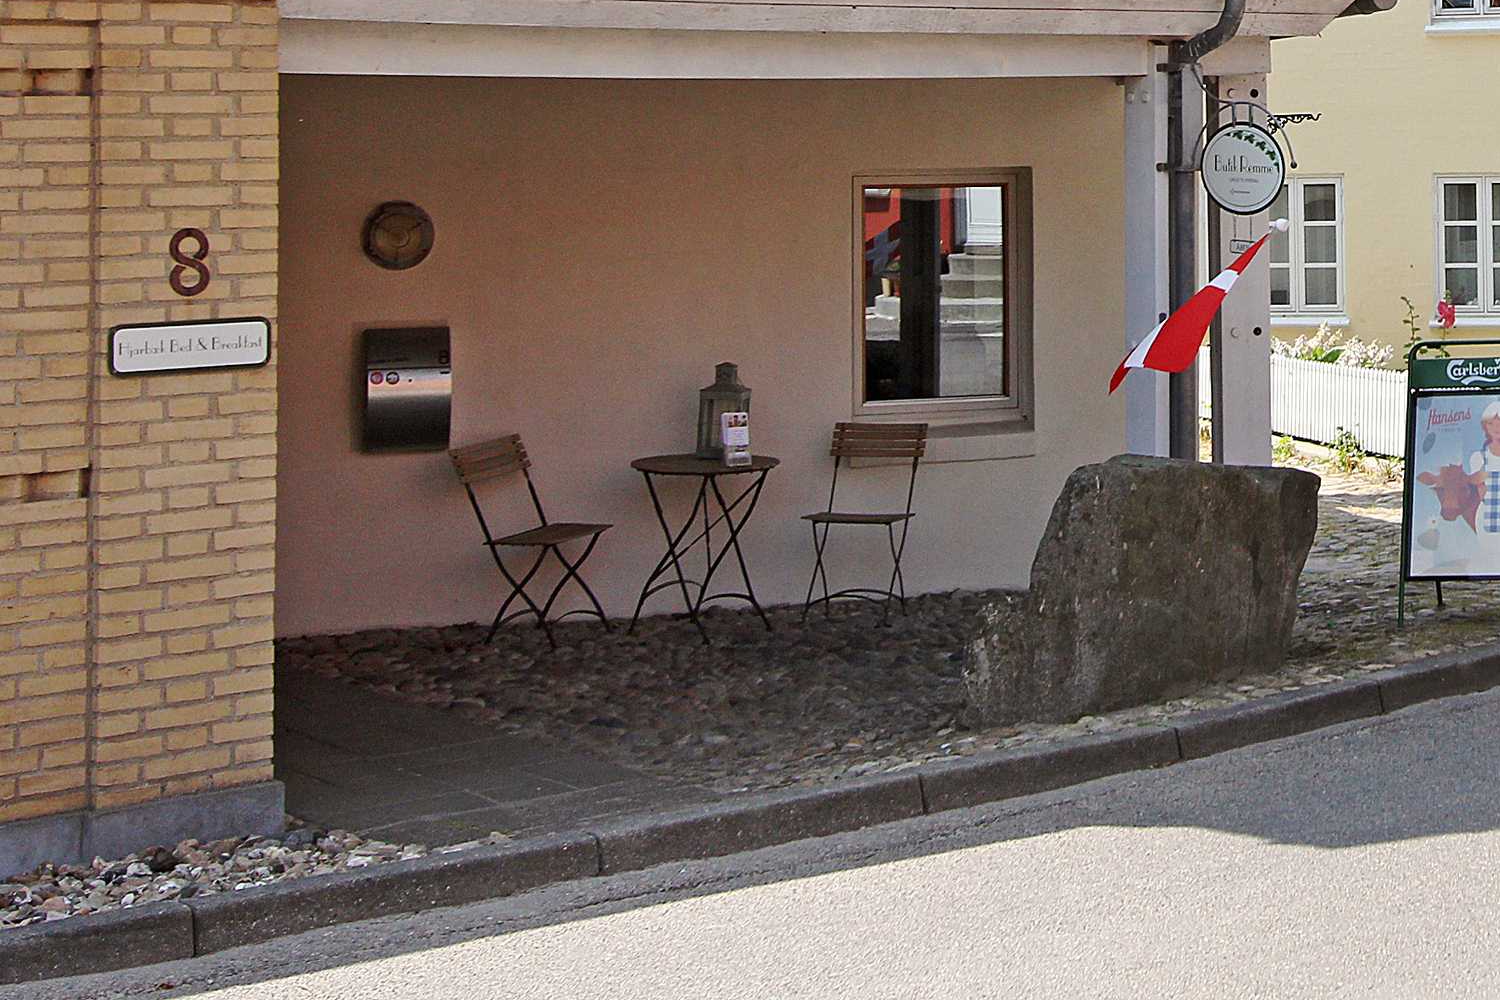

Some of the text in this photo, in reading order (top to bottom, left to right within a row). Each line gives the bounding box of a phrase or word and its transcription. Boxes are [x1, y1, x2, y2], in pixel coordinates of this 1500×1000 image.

[168, 227, 210, 297] 8
[169, 338, 192, 353] Bed
[211, 334, 262, 351] Breakfast
[1426, 407, 1472, 432] Hansens
